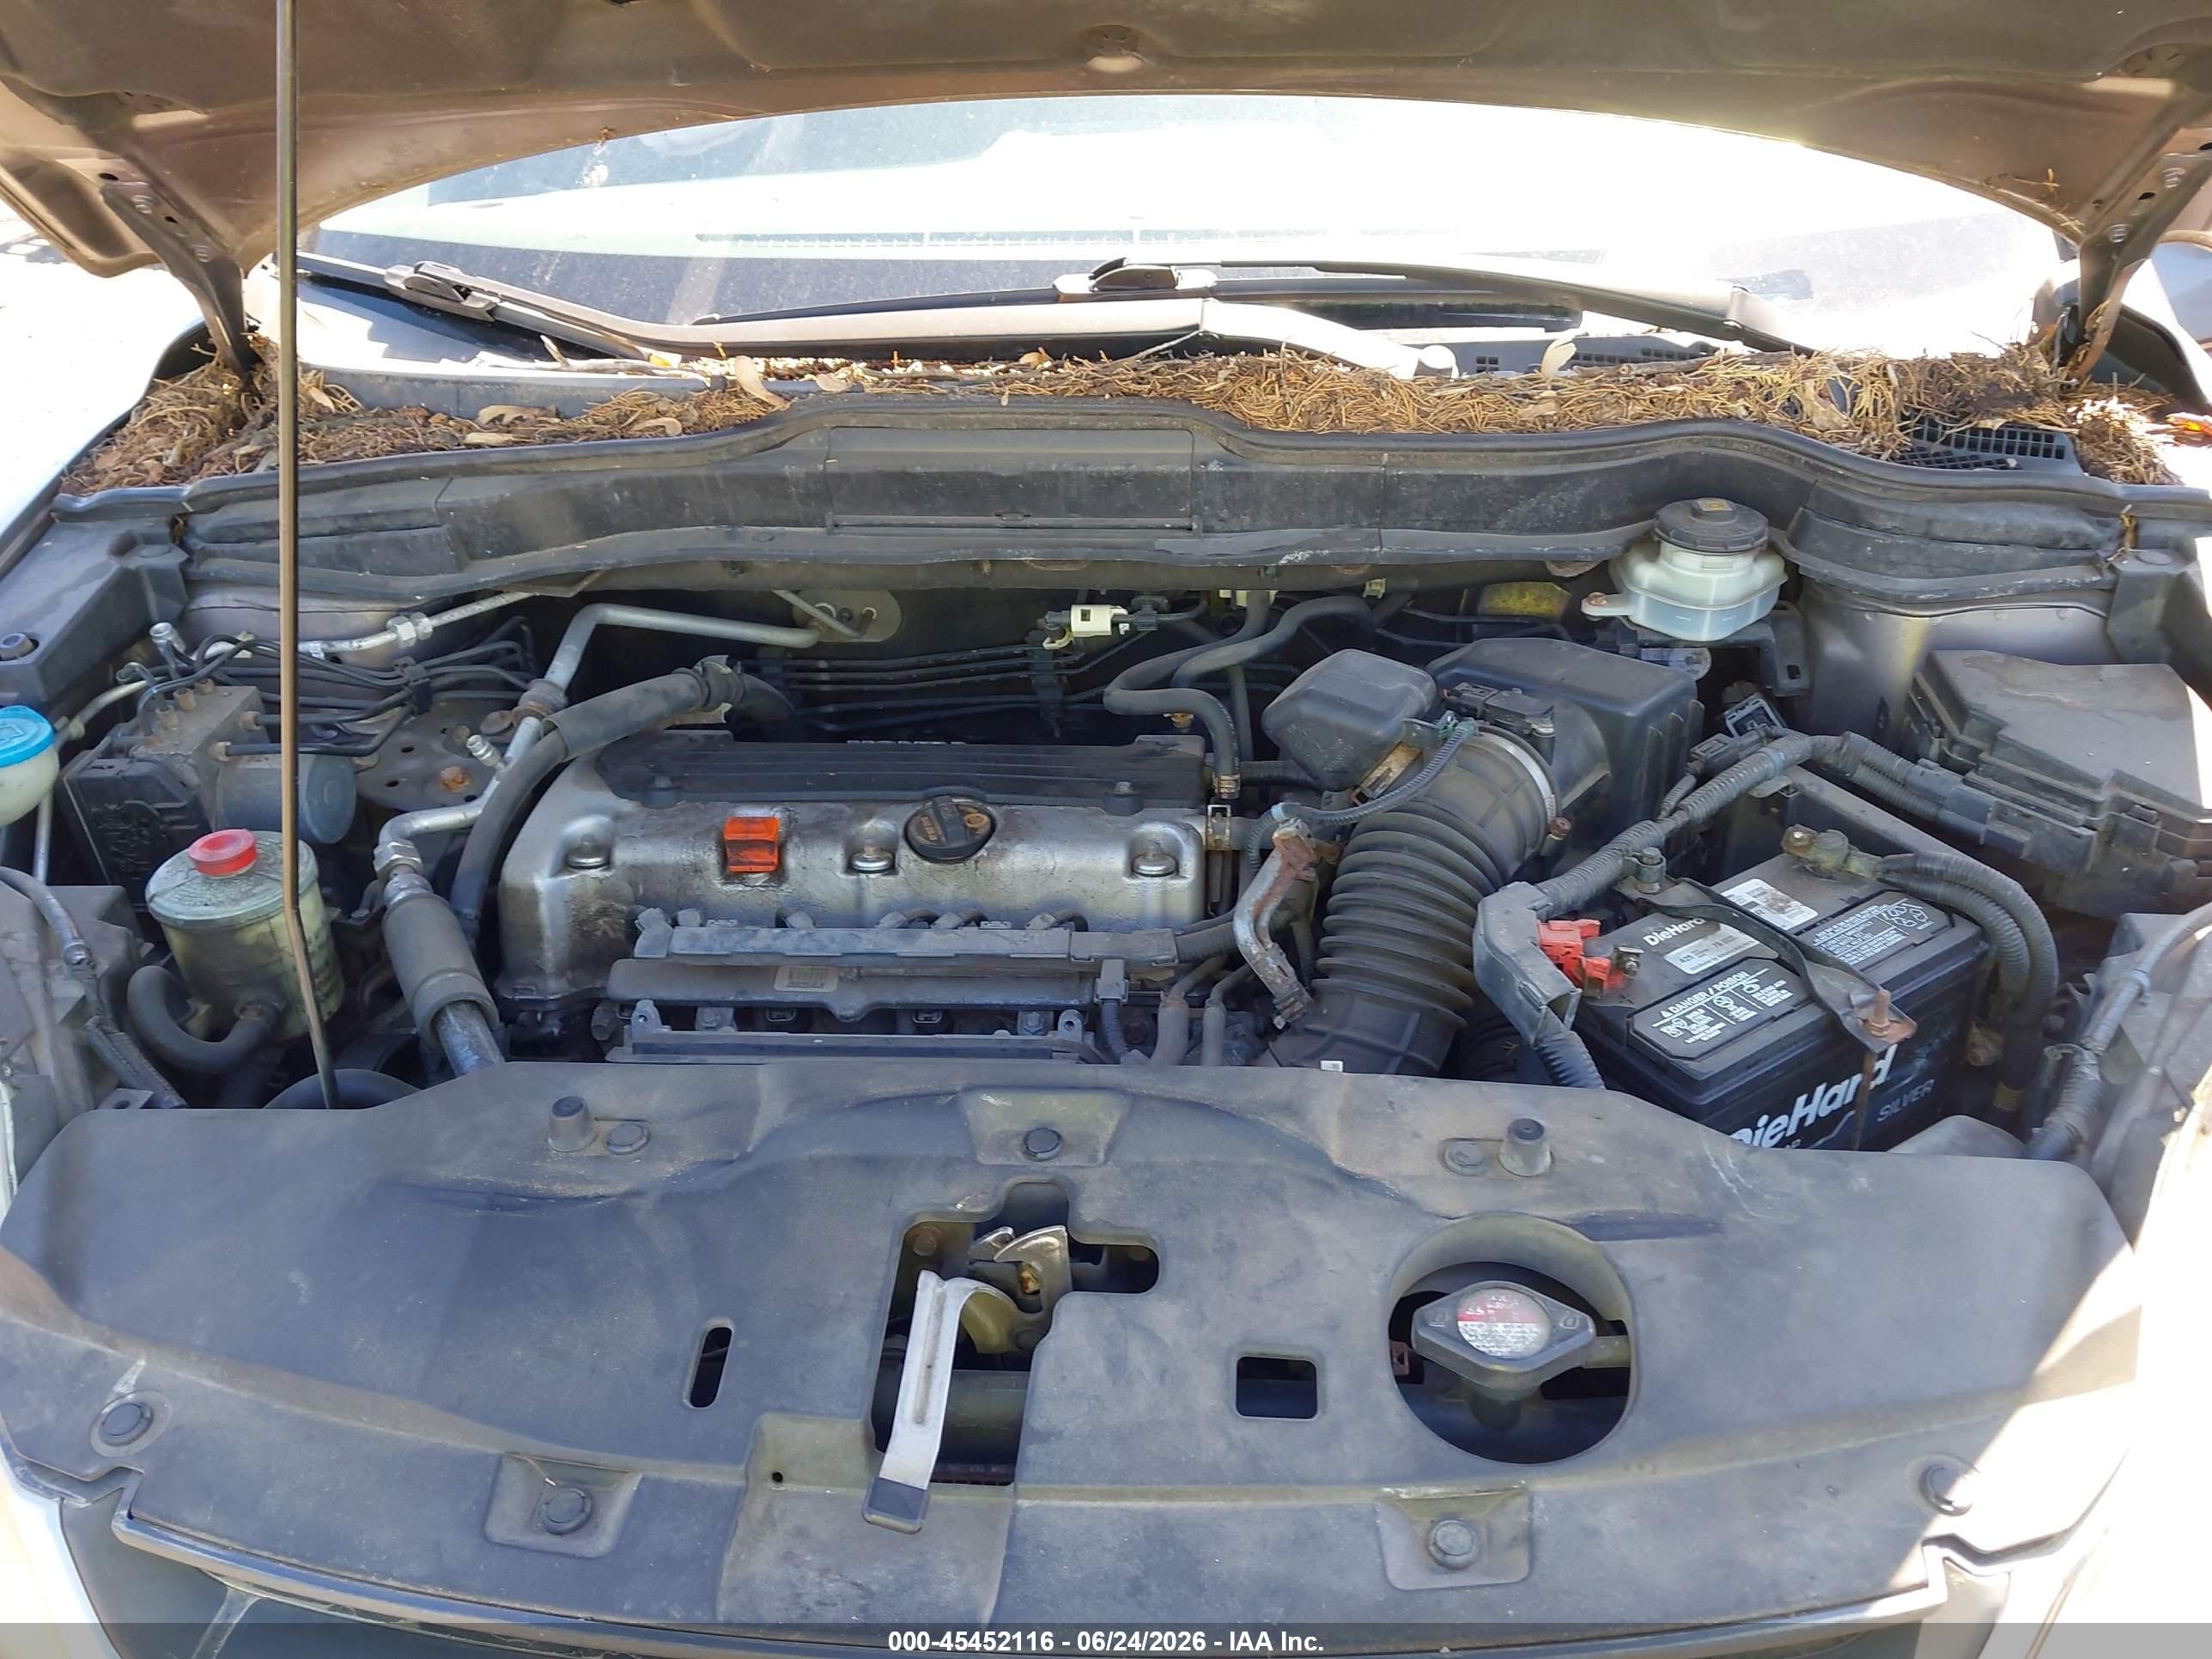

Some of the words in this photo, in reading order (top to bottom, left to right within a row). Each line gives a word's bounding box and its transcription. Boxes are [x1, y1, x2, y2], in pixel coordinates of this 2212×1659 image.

[1668, 991, 1710, 1013] DANGER
[1712, 970, 1751, 992] POISON
[1877, 1079, 1936, 1123] SILVER
